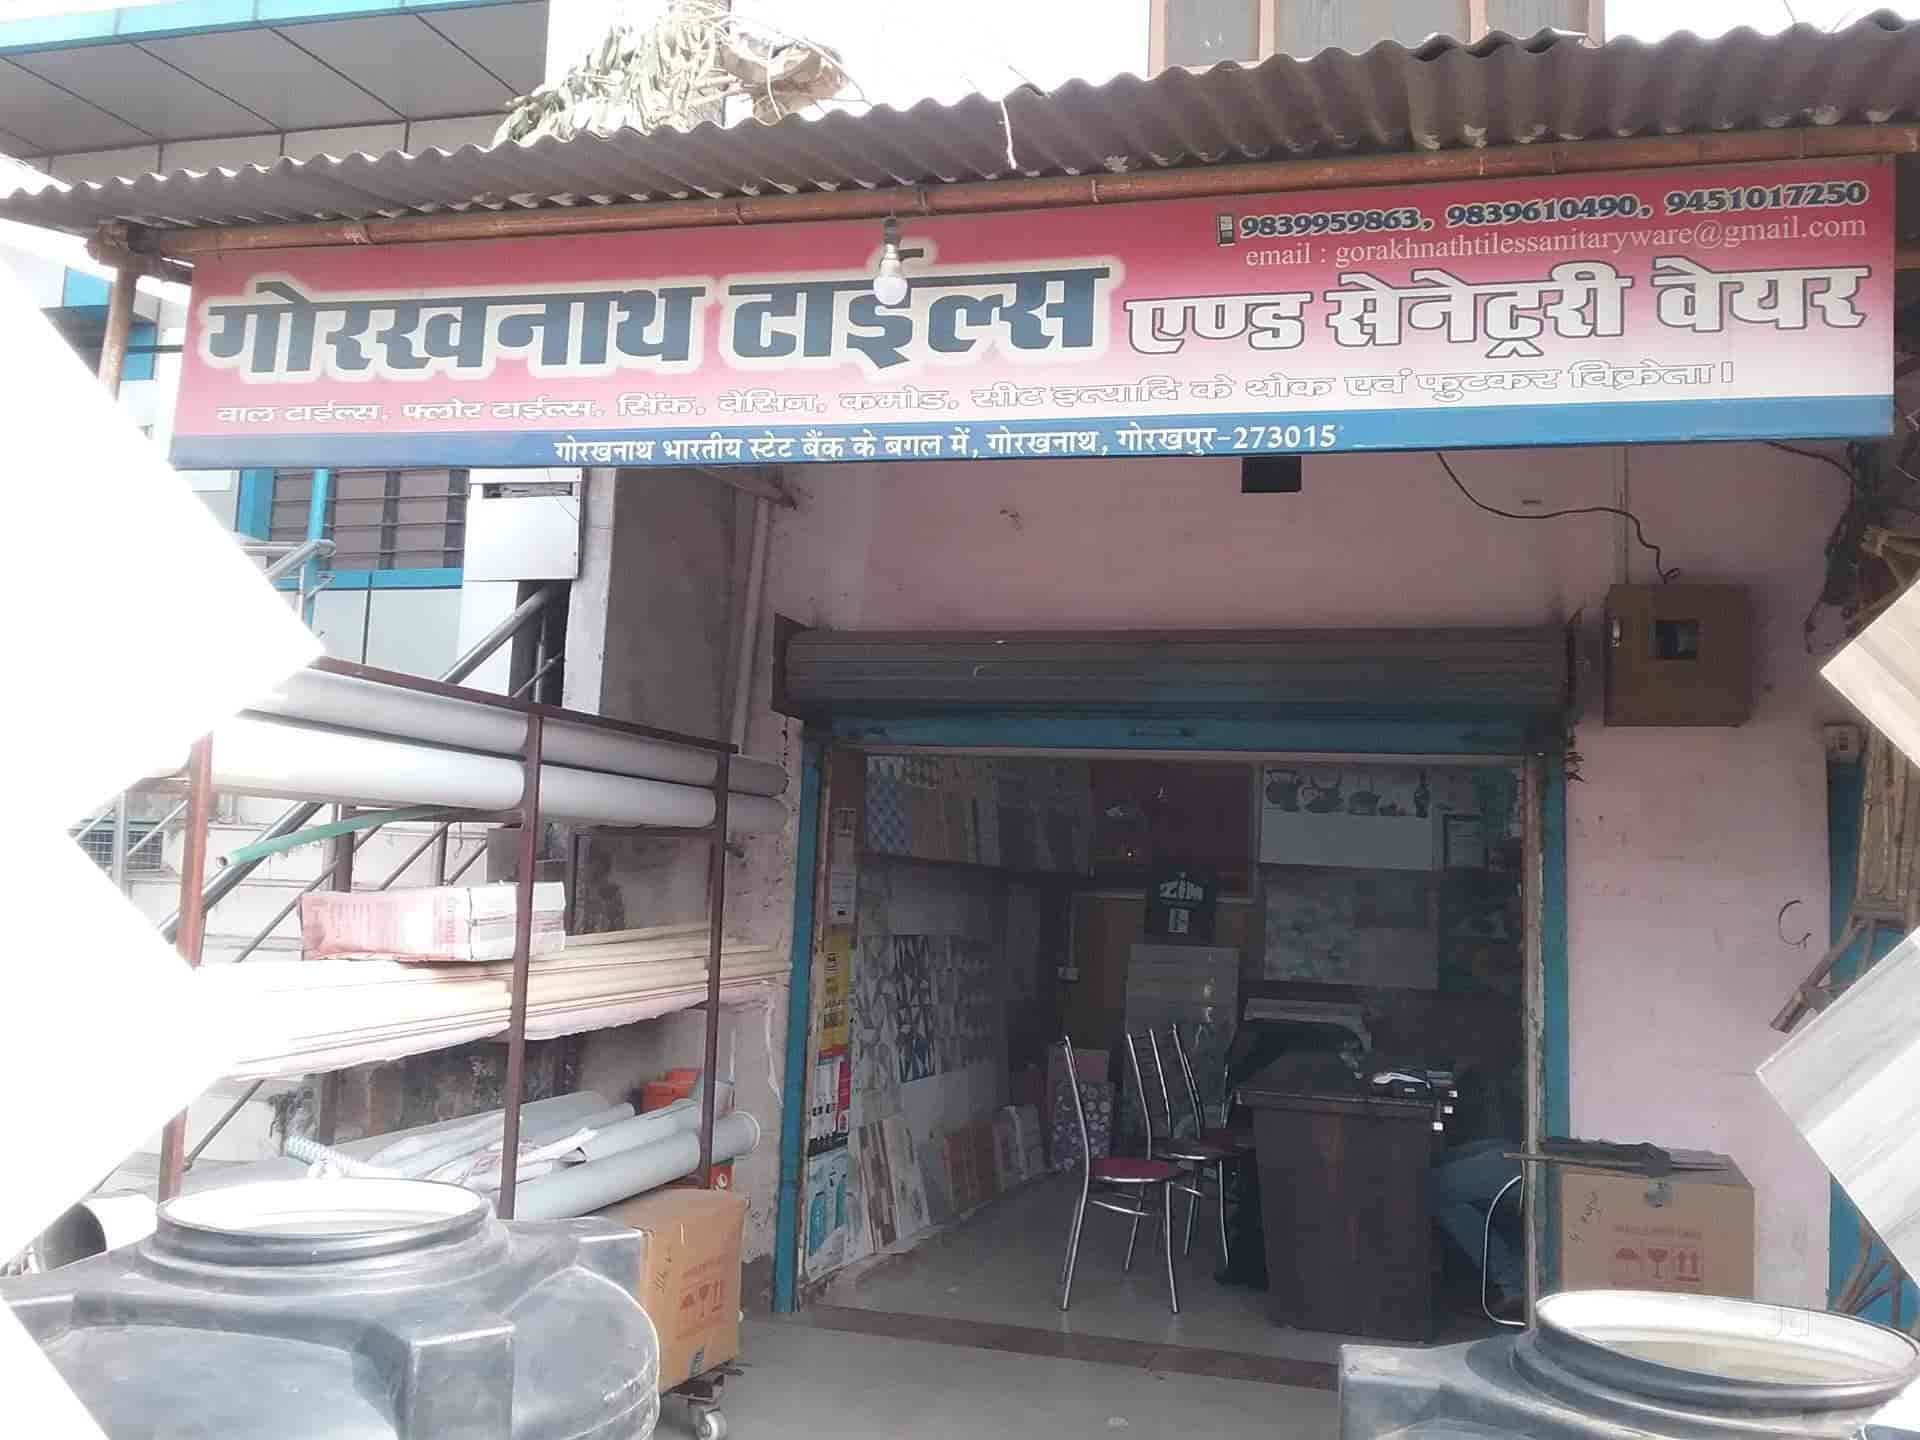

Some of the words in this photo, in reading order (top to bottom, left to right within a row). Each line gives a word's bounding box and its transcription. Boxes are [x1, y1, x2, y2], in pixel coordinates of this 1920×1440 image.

[1240, 206, 1434, 238] 9839959863,
[1446, 194, 1653, 229] 9839610490,
[1664, 180, 1869, 216] 9451017250
[1246, 243, 1311, 266] email
[1335, 215, 1866, 268] gorakhnathtilessanitaryware@gmail.com
[207, 280, 707, 374] गोरखनाथ
[1123, 291, 1313, 354] एण्ड
[1651, 255, 1872, 332] वेयर
[970, 380, 1047, 407] सीट
[1189, 374, 1236, 400] के
[1245, 373, 1337, 398] थोक
[1344, 368, 1414, 396] एवं
[553, 435, 656, 463] गोरखनाथ
[662, 431, 743, 461] भारतीय
[748, 431, 795, 459] स्टेट
[801, 429, 846, 459] बैंक
[850, 428, 877, 457] के
[884, 434, 943, 457] बगल
[948, 426, 979, 459] में,
[986, 425, 1108, 456] गोरखनाथ,
[1116, 422, 1337, 456] गोरखपुर-273015
